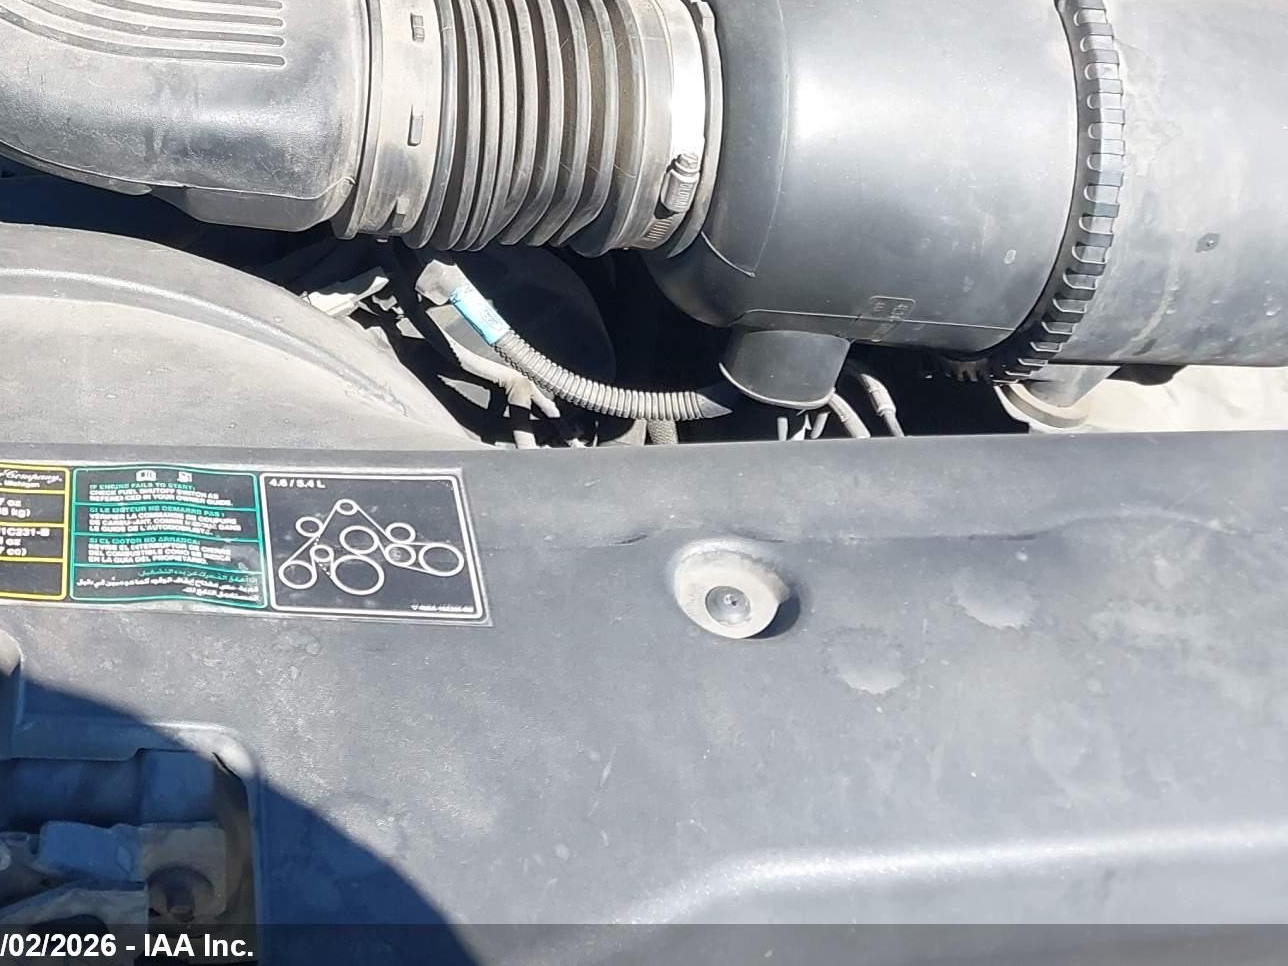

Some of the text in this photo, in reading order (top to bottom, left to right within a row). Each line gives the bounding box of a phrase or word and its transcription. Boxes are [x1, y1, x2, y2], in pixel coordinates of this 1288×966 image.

[3, 479, 41, 489] Michigan
[268, 478, 288, 488] 4.6
[296, 478, 315, 488] 5.4
[316, 479, 327, 489] L
[6, 499, 22, 507] oz
[10, 507, 31, 519] kg)
[126, 512, 138, 520] LA
[5, 538, 21, 546] oz
